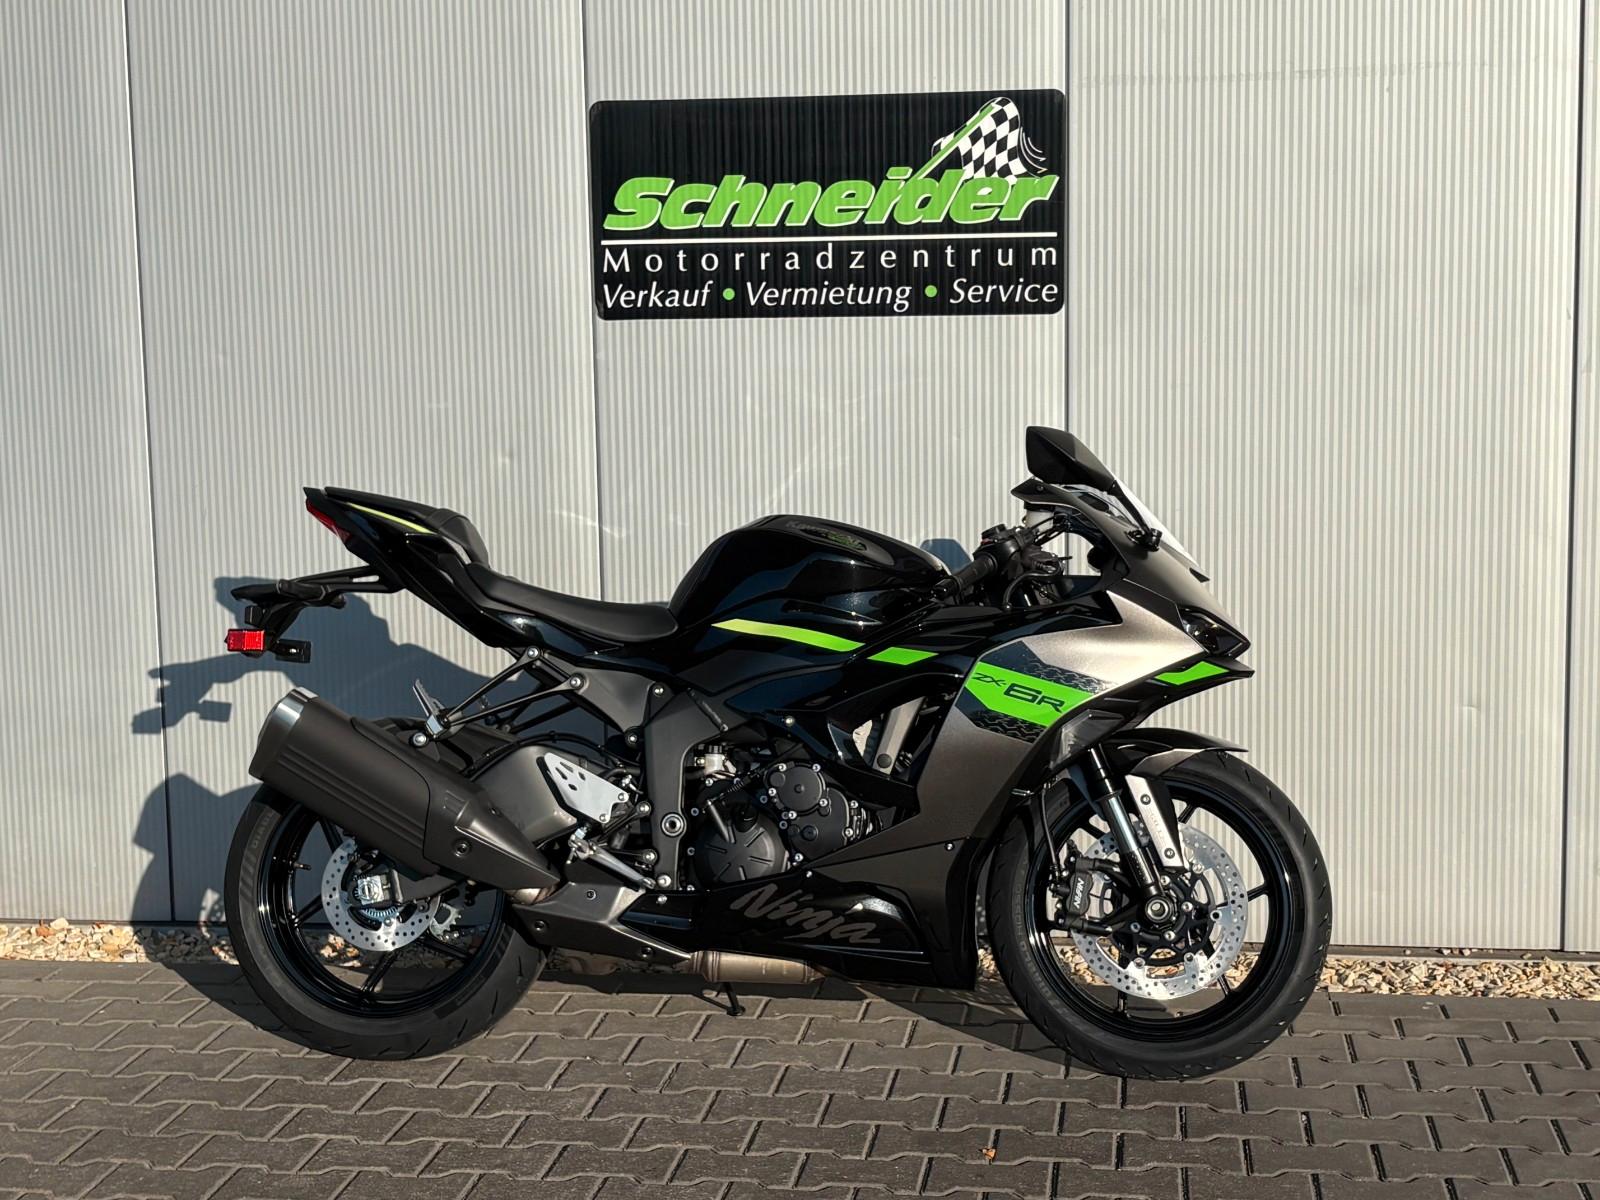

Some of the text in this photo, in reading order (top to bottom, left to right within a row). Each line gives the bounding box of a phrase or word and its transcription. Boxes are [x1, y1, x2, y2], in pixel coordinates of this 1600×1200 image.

[603, 167, 1059, 231] Schneider
[602, 243, 1057, 273] Motorradzentrum
[603, 278, 1058, 312] Verkauf Vermietung Service
[729, 883, 881, 944] Ninja
